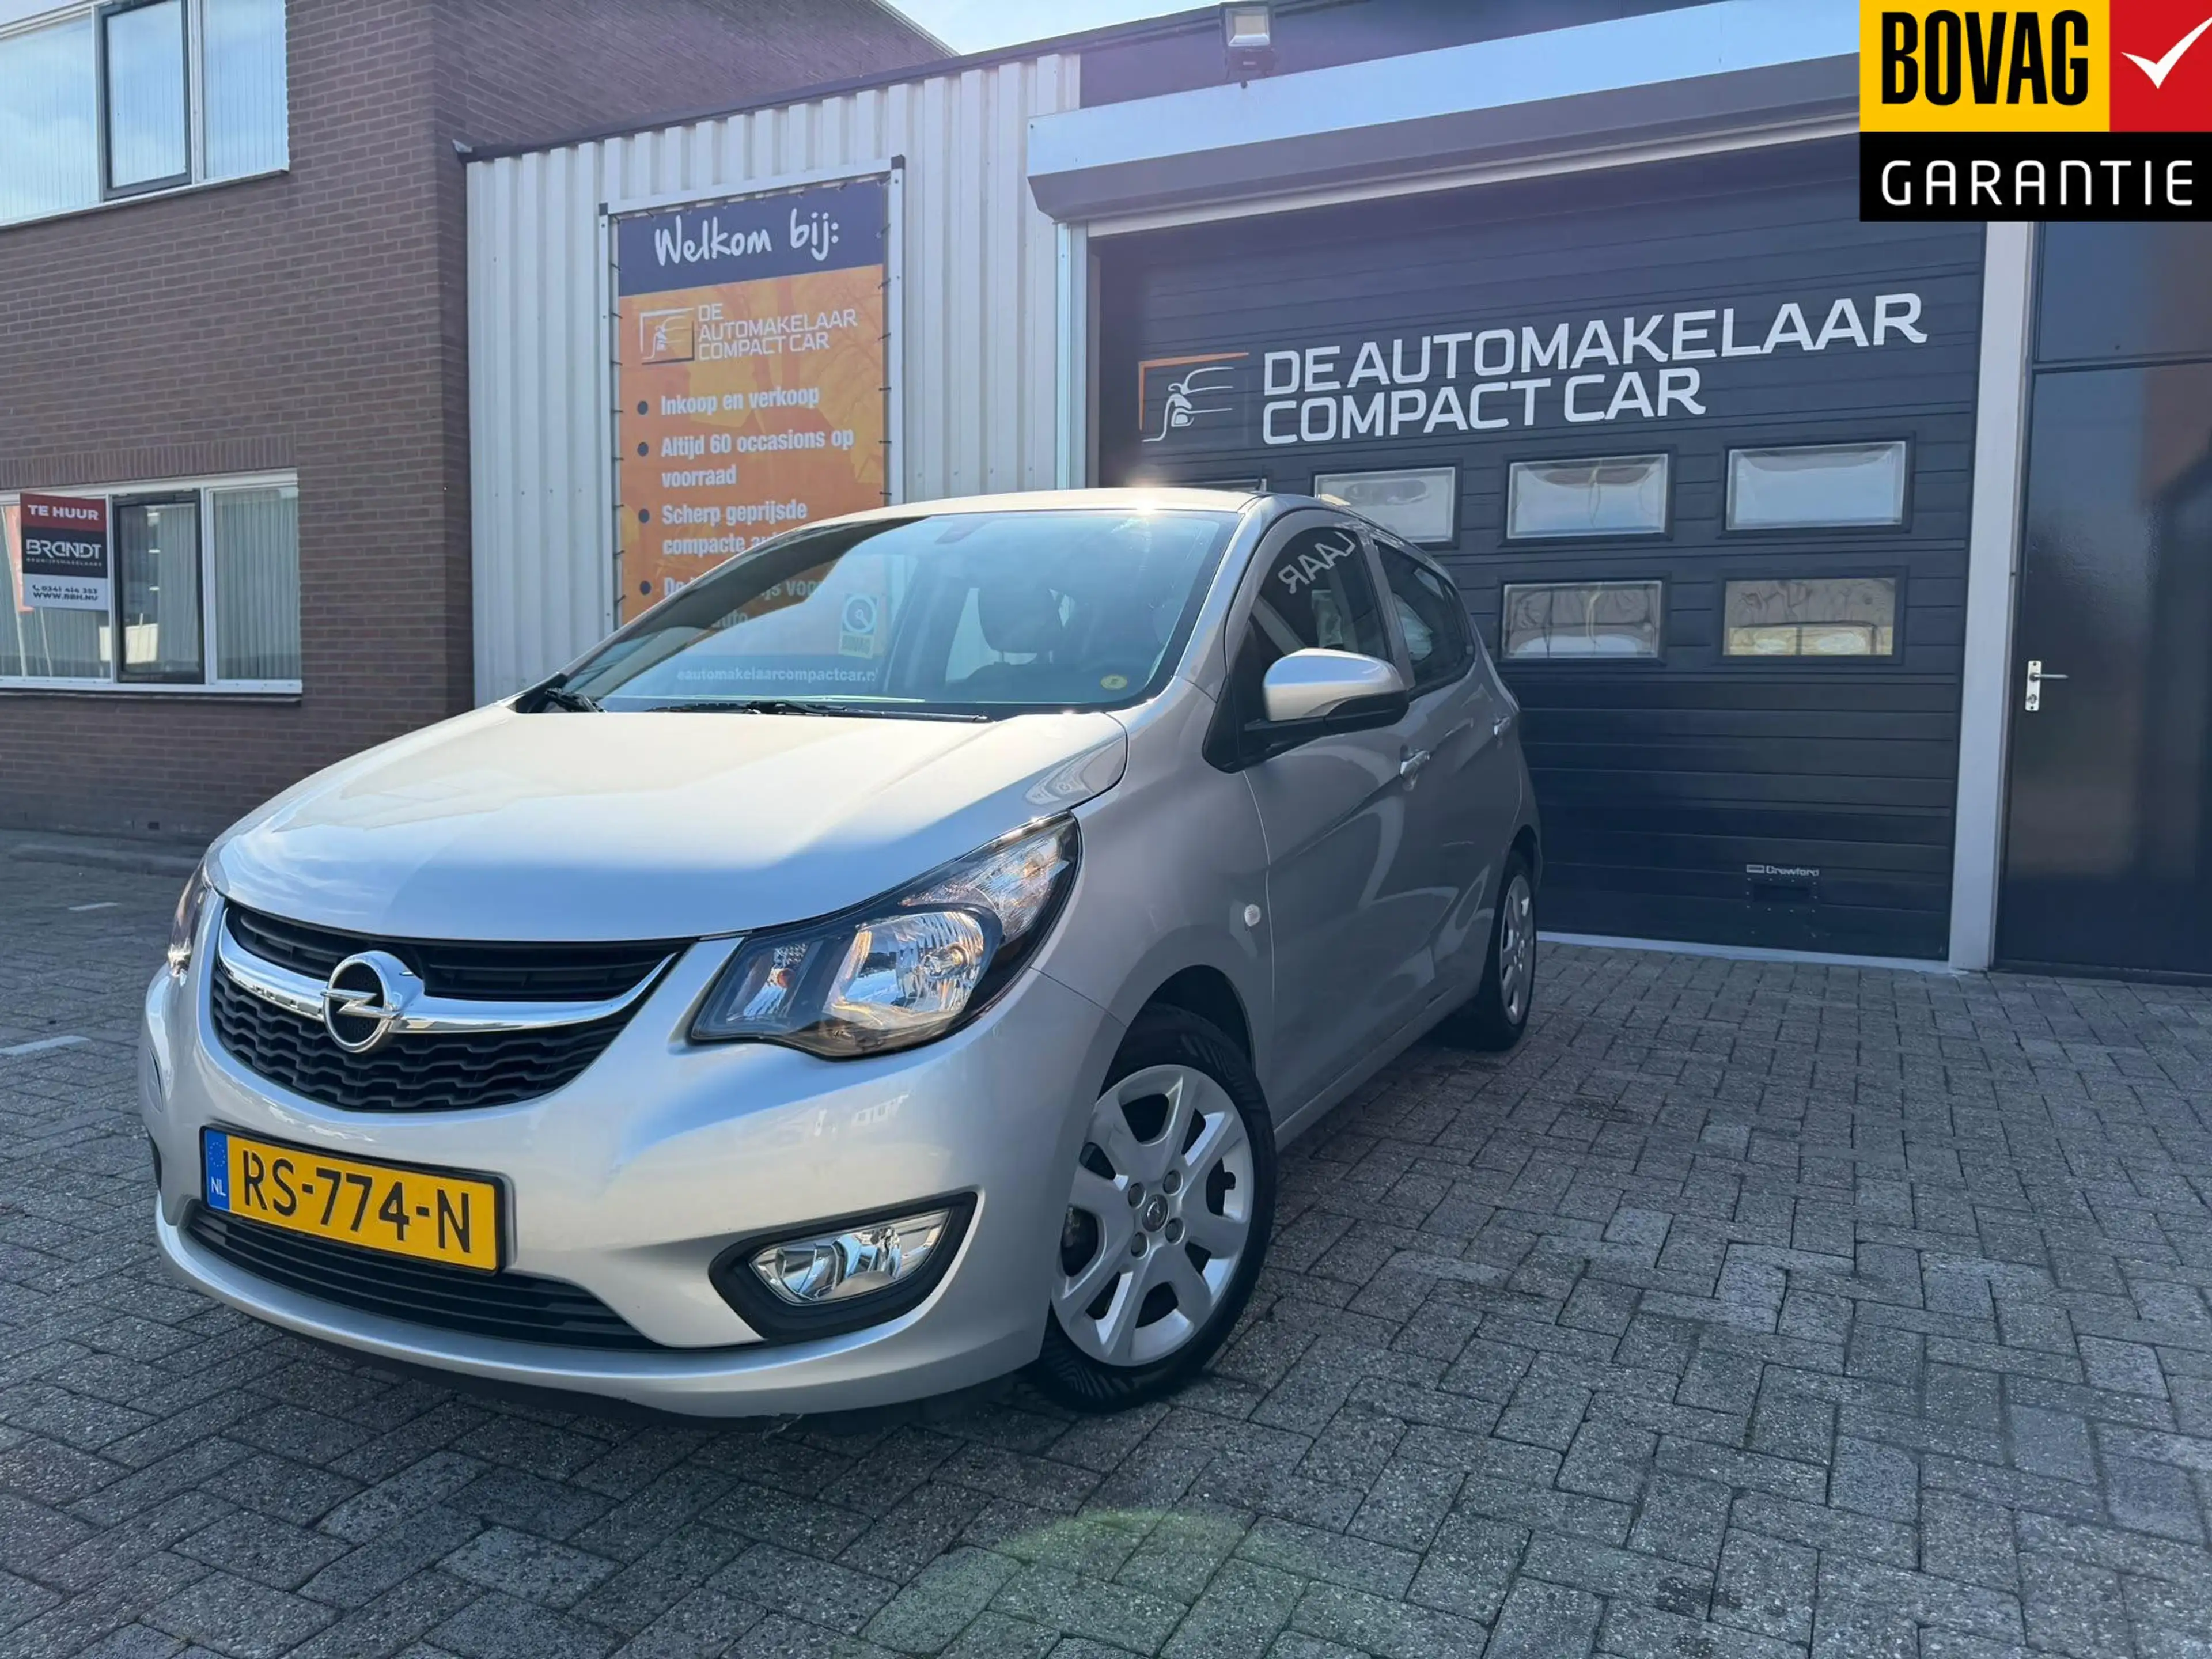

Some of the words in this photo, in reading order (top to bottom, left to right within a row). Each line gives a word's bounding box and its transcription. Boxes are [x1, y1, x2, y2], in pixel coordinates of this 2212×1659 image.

[654, 215, 772, 267] Welkom
[790, 208, 839, 261] bij:
[698, 303, 724, 322] DE
[699, 308, 858, 342] AUTOMAKELAAR
[698, 336, 786, 361] COMPACT
[790, 332, 830, 352] CAR
[1264, 346, 1342, 396] DE
[1347, 293, 1928, 388] AUTOMAKELAAR
[661, 395, 717, 416] Inkoop
[722, 393, 743, 409] en
[749, 385, 819, 407] verkoop
[1263, 378, 1551, 445] COMPACT
[1564, 367, 1706, 422] CAR
[661, 435, 704, 460] Altijd
[710, 433, 732, 454] 60
[737, 429, 825, 452] occasions
[831, 428, 854, 450] op
[661, 464, 737, 488] voorraad
[28, 504, 50, 516] TE
[52, 506, 99, 521] HUUR
[662, 504, 721, 527] Scherp
[726, 499, 808, 524] geprijsde
[26, 539, 102, 559] BRANDT
[662, 533, 745, 557] compacte
[210, 1176, 226, 1196] NL
[242, 1150, 472, 1253] RS-774-N
